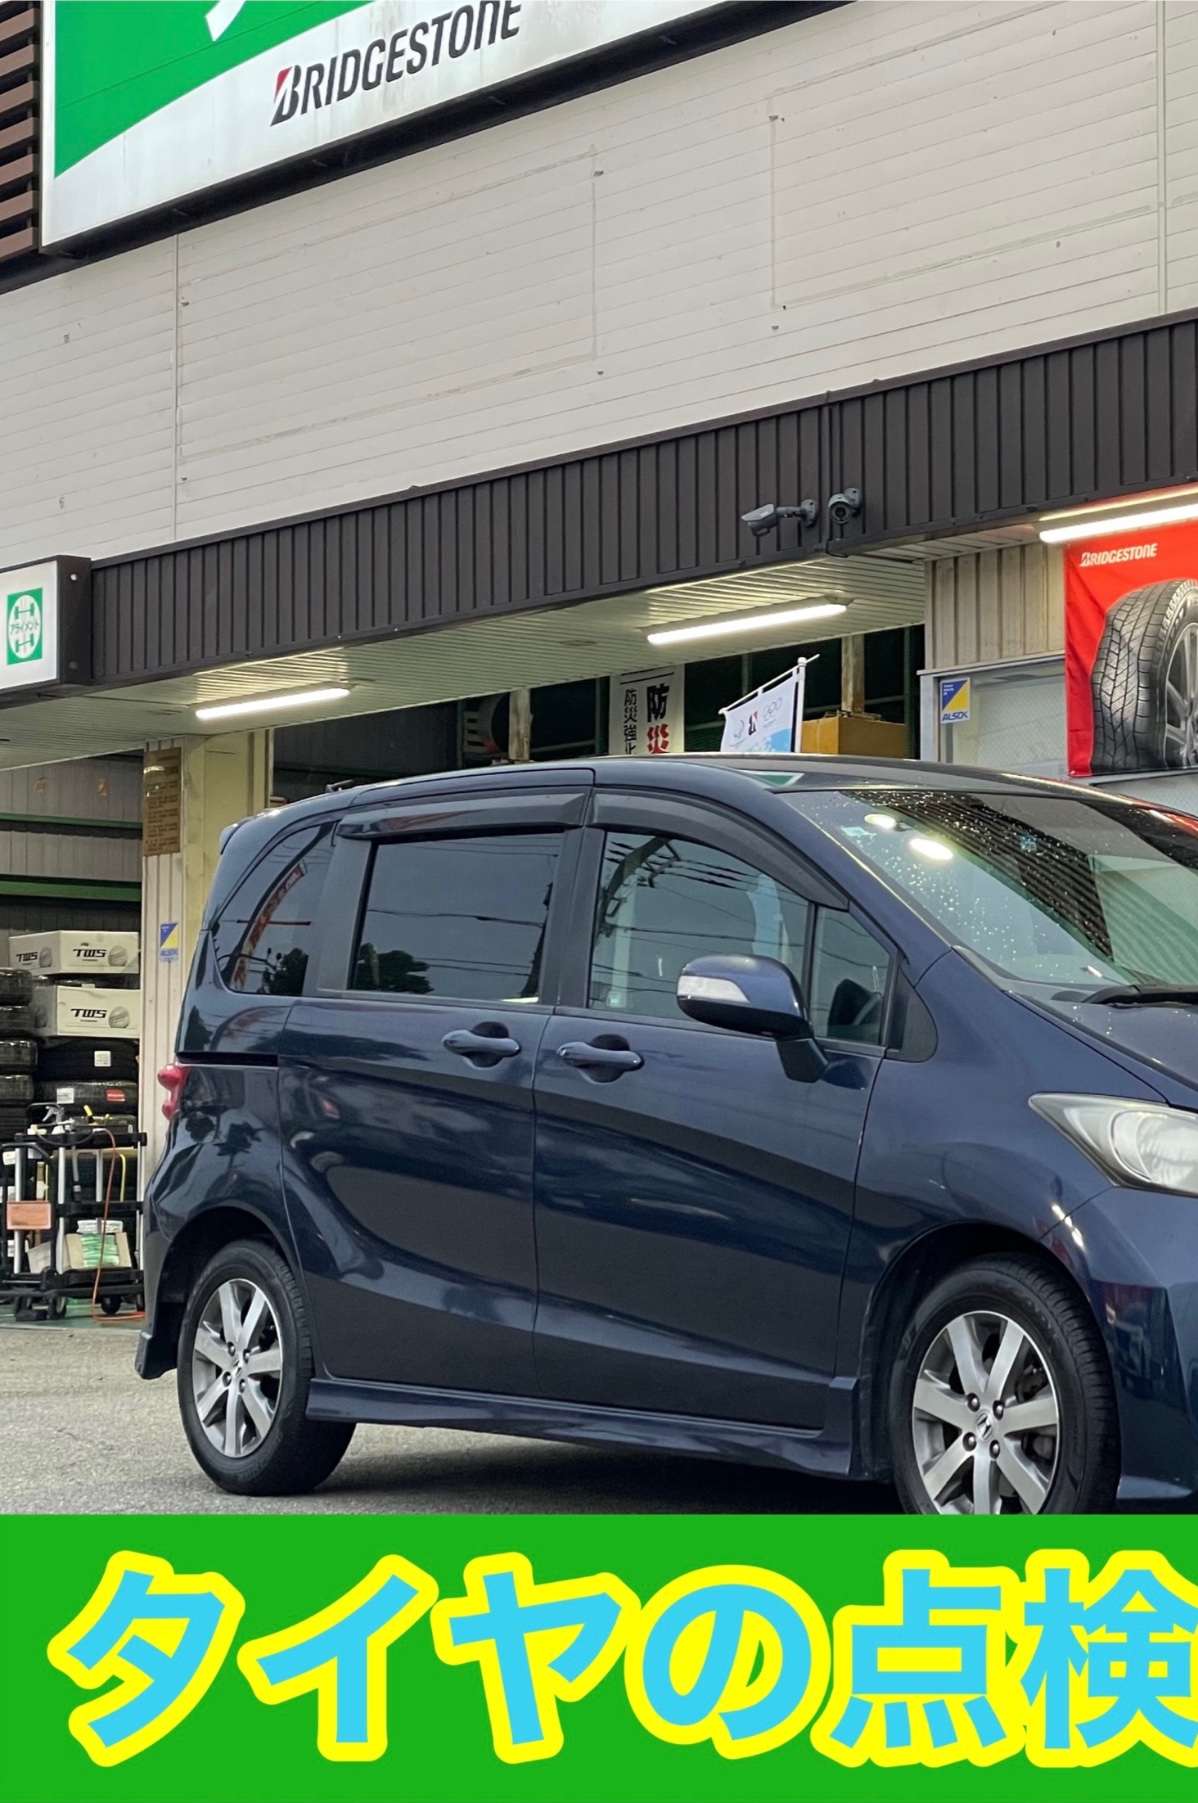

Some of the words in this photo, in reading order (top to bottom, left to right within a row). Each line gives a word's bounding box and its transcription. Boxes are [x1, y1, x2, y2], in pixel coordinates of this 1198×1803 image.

[270, 0, 522, 126] BRIDGESTONE
[1080, 543, 1158, 567] BRIDGESTONE
[16, 951, 38, 962] TWS
[73, 948, 107, 958] TWS
[71, 1008, 107, 1018] TWS
